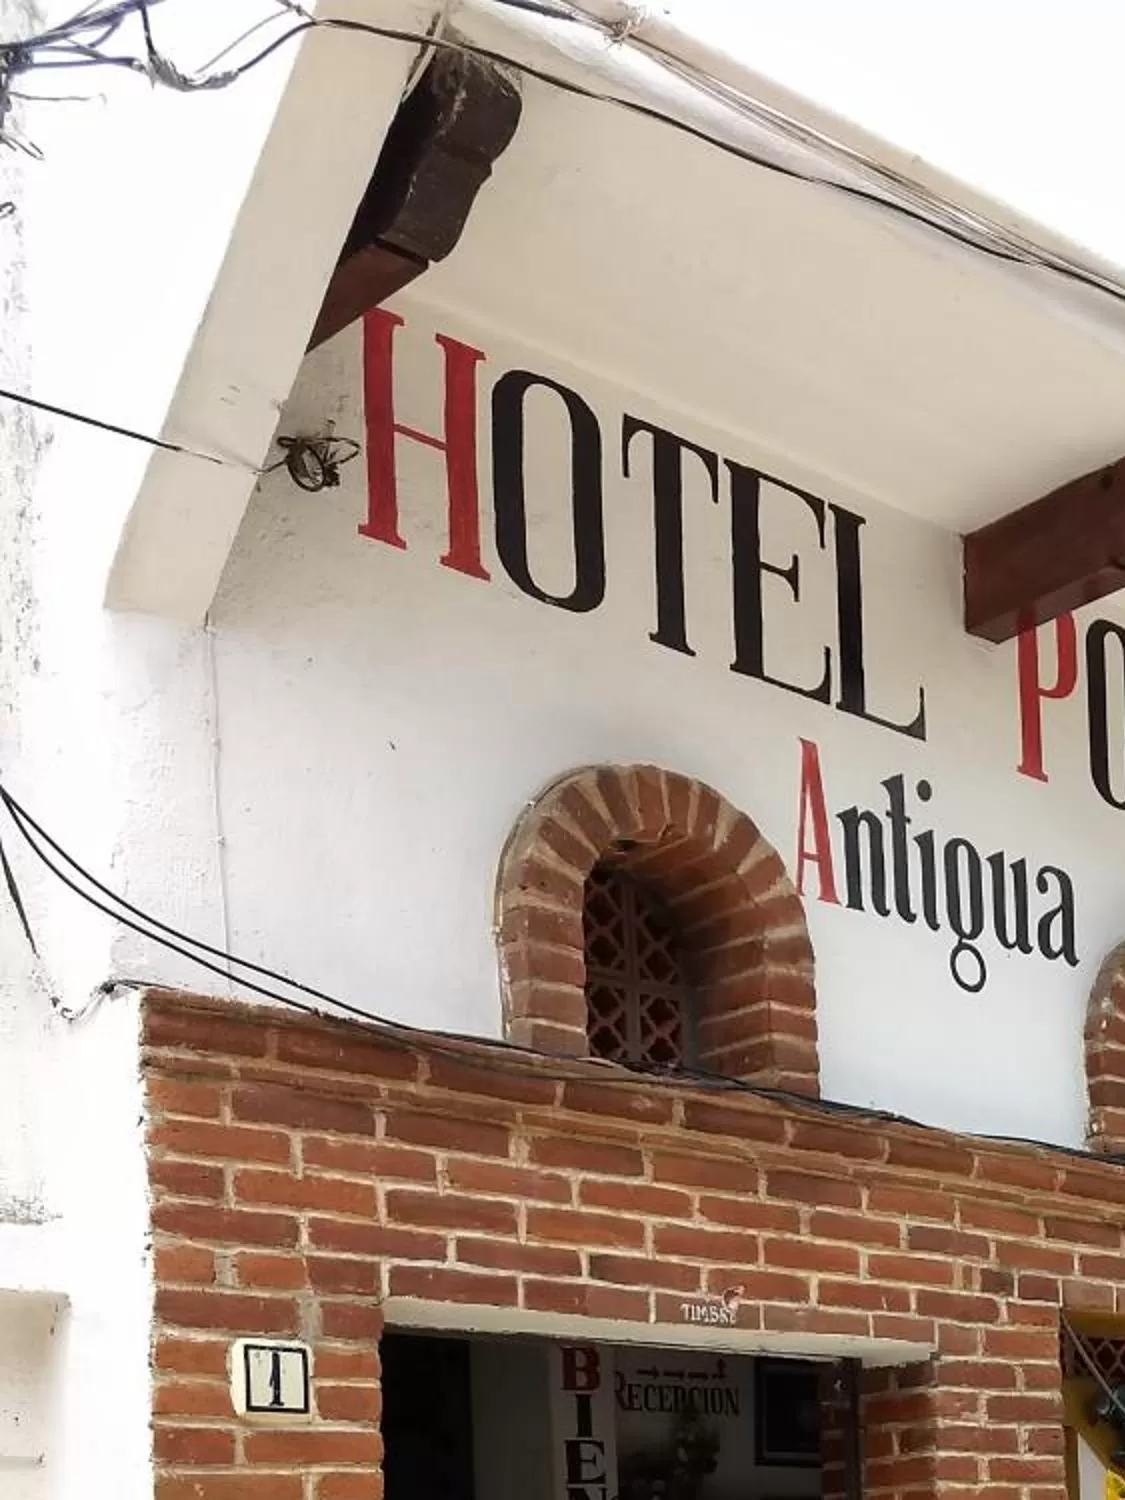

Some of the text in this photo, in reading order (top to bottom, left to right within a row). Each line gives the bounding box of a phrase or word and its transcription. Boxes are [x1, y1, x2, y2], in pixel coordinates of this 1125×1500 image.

[358, 308, 926, 741] HOTEL
[796, 737, 1080, 993] Antigua
[269, 1352, 284, 1406] 1
